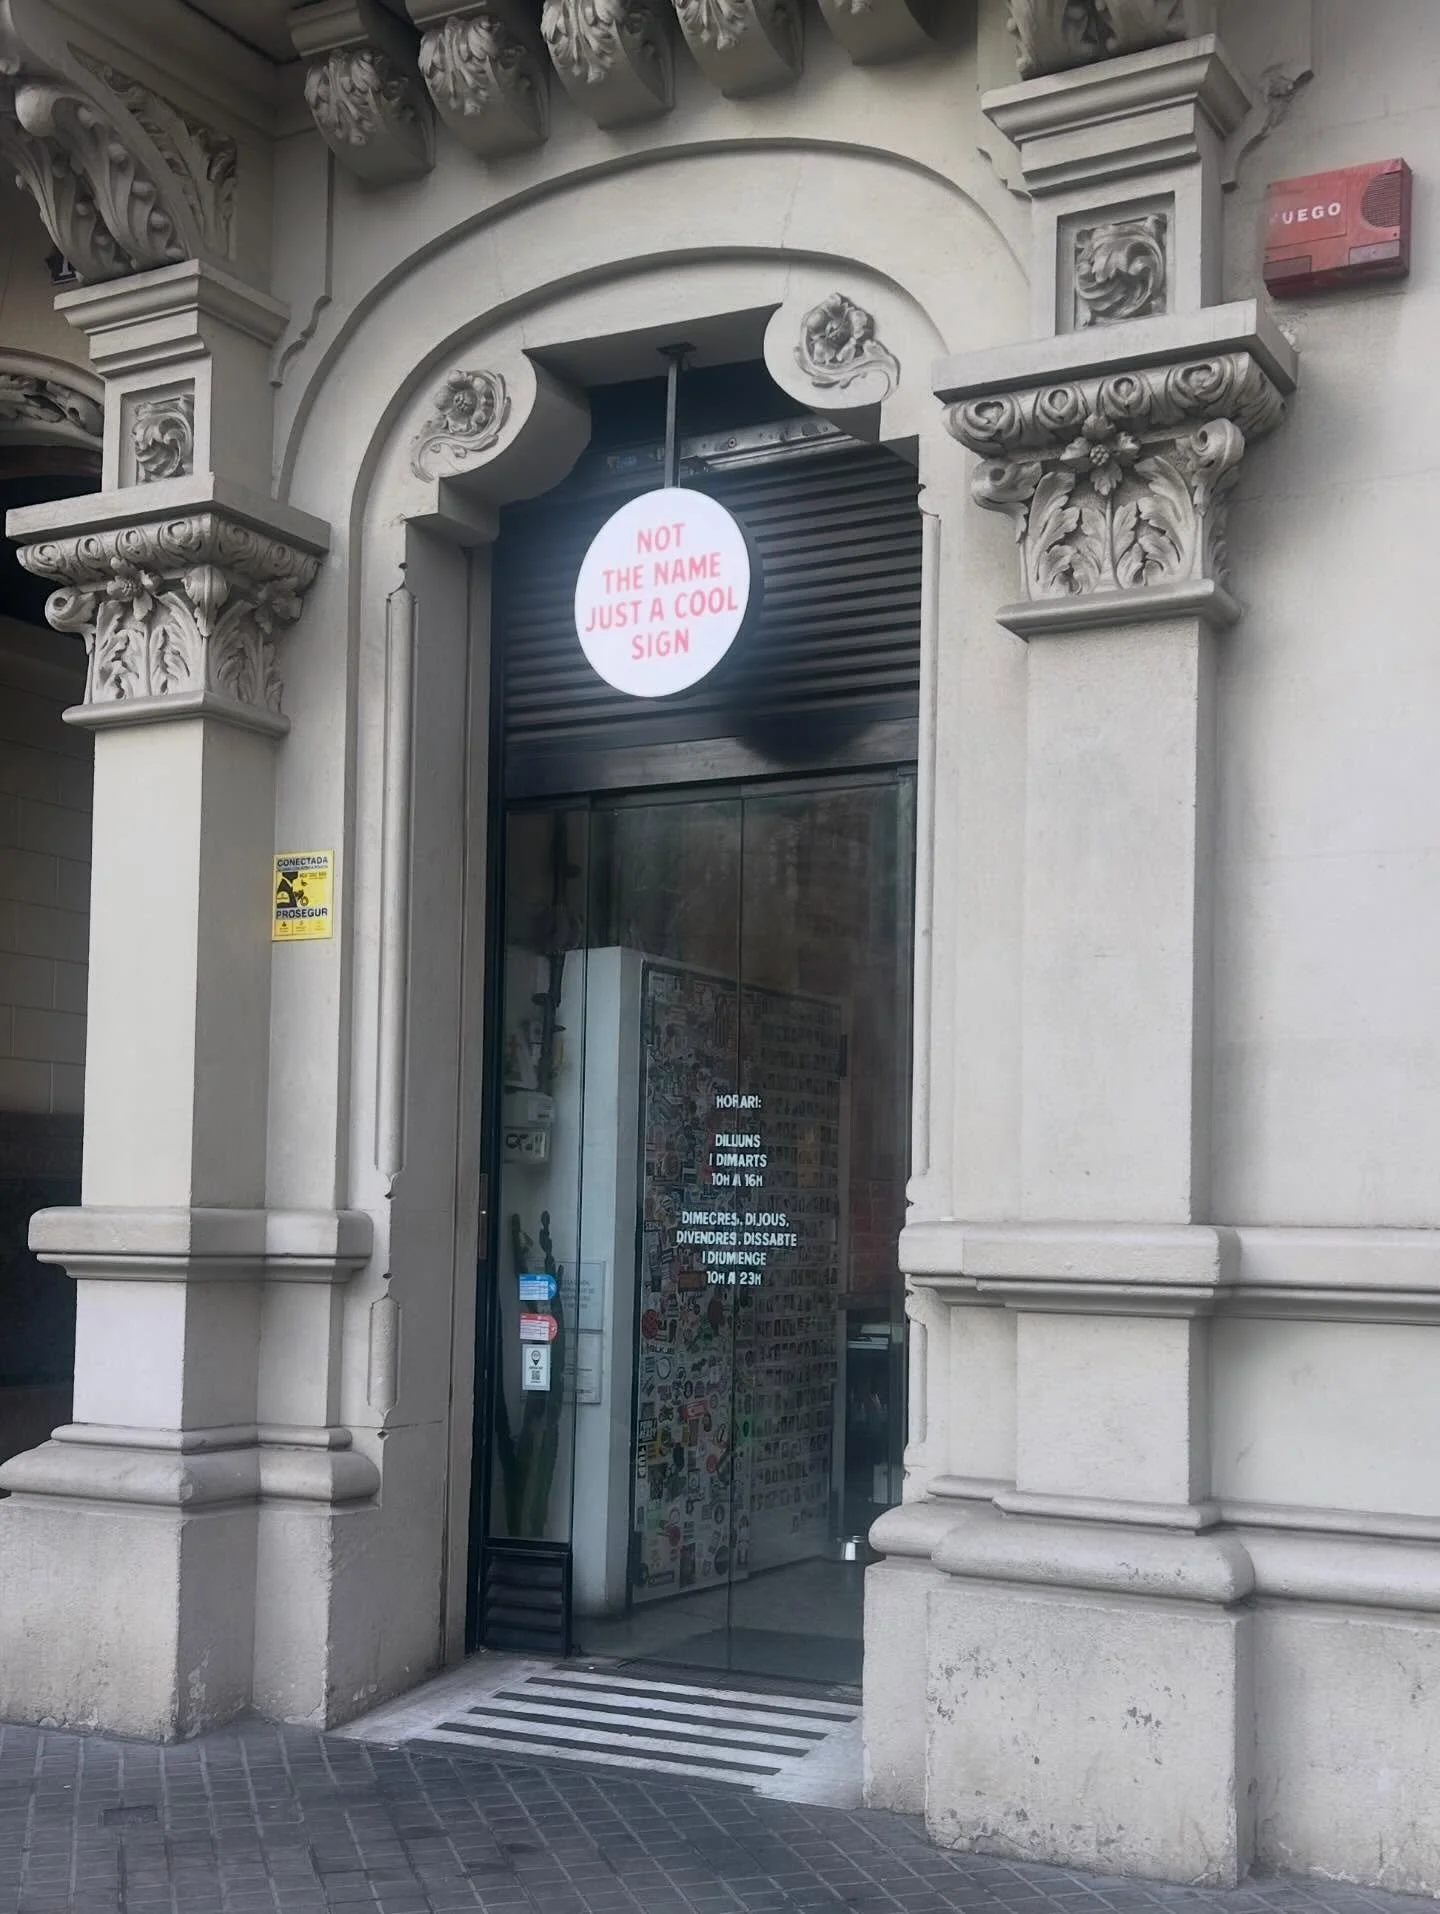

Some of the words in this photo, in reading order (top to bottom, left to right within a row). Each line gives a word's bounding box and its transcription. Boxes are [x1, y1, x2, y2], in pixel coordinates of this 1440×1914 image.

[637, 523, 685, 554] NOT
[602, 564, 644, 595] THE
[653, 551, 721, 587] NAME
[585, 600, 642, 633] JUST
[649, 597, 665, 623] A
[674, 586, 738, 619] COOL
[631, 628, 690, 660] SIGN
[277, 857, 328, 867] CONECTADA
[276, 908, 328, 920] PROSEGUR
[716, 1095, 762, 1109] HORARI:
[715, 1134, 761, 1148] DILLUNS
[709, 1154, 713, 1167] I
[716, 1154, 768, 1168] DIMARTS
[712, 1173, 730, 1187] 10H
[732, 1173, 742, 1187] A
[745, 1174, 763, 1188] 16H
[743, 1232, 798, 1247] DISSABTE
[702, 1251, 706, 1264] I
[707, 1251, 767, 1266] DIUMENGE
[706, 1271, 725, 1286] 10H
[727, 1271, 736, 1286] A
[739, 1272, 762, 1287] 23H
